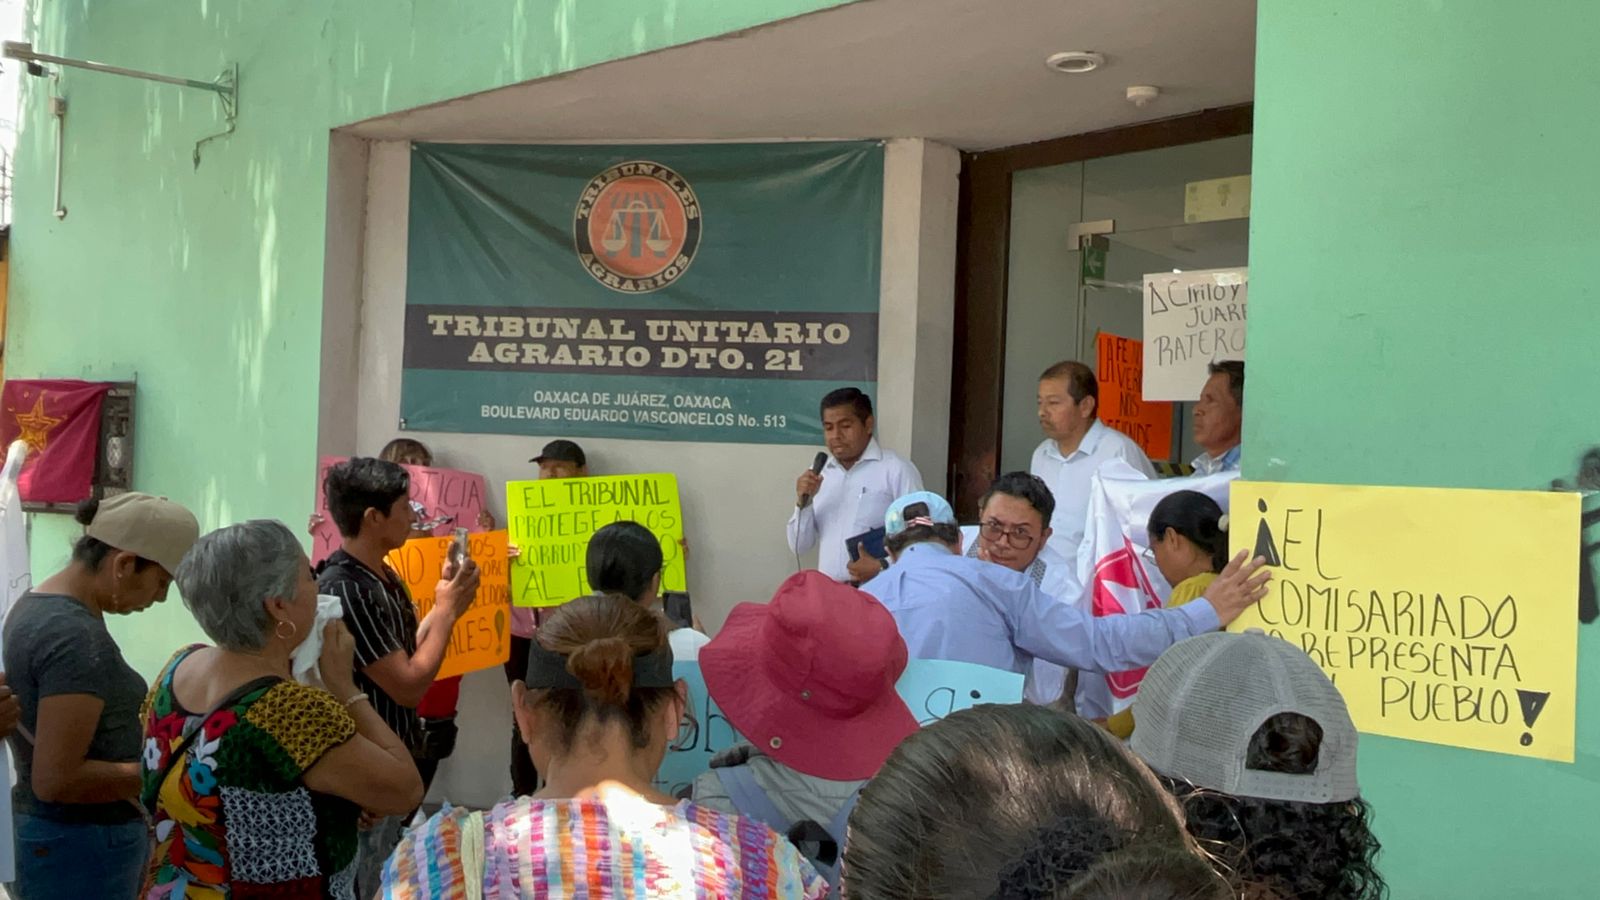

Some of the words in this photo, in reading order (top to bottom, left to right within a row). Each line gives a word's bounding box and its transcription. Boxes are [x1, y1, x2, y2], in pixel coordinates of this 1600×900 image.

[578, 164, 698, 219] TRIBUNALES
[581, 254, 689, 291] AGRARIOS
[427, 314, 636, 341] TRIBUNAL
[646, 319, 850, 345] UNITARIO
[467, 341, 650, 368] AGRARIO
[660, 347, 753, 371] DTO.
[764, 349, 803, 371] 21
[533, 390, 589, 404] OAXACA
[592, 393, 610, 406] DE
[614, 390, 670, 408] JUÁREZ,
[673, 394, 732, 409] OAXACA
[481, 405, 560, 420] BOULEVARD
[564, 408, 629, 422] EDUARDO
[632, 410, 734, 427] VASCONCELOS
[738, 414, 760, 427] No.
[763, 415, 786, 427] 513
[523, 485, 556, 509] EL
[563, 479, 670, 506] TRIBUNAL
[523, 570, 565, 600] AL
[1257, 578, 1518, 640] COMISARIADO
[1301, 631, 1521, 682] REPRESENTA
[1380, 676, 1551, 747] PUEBLO!
